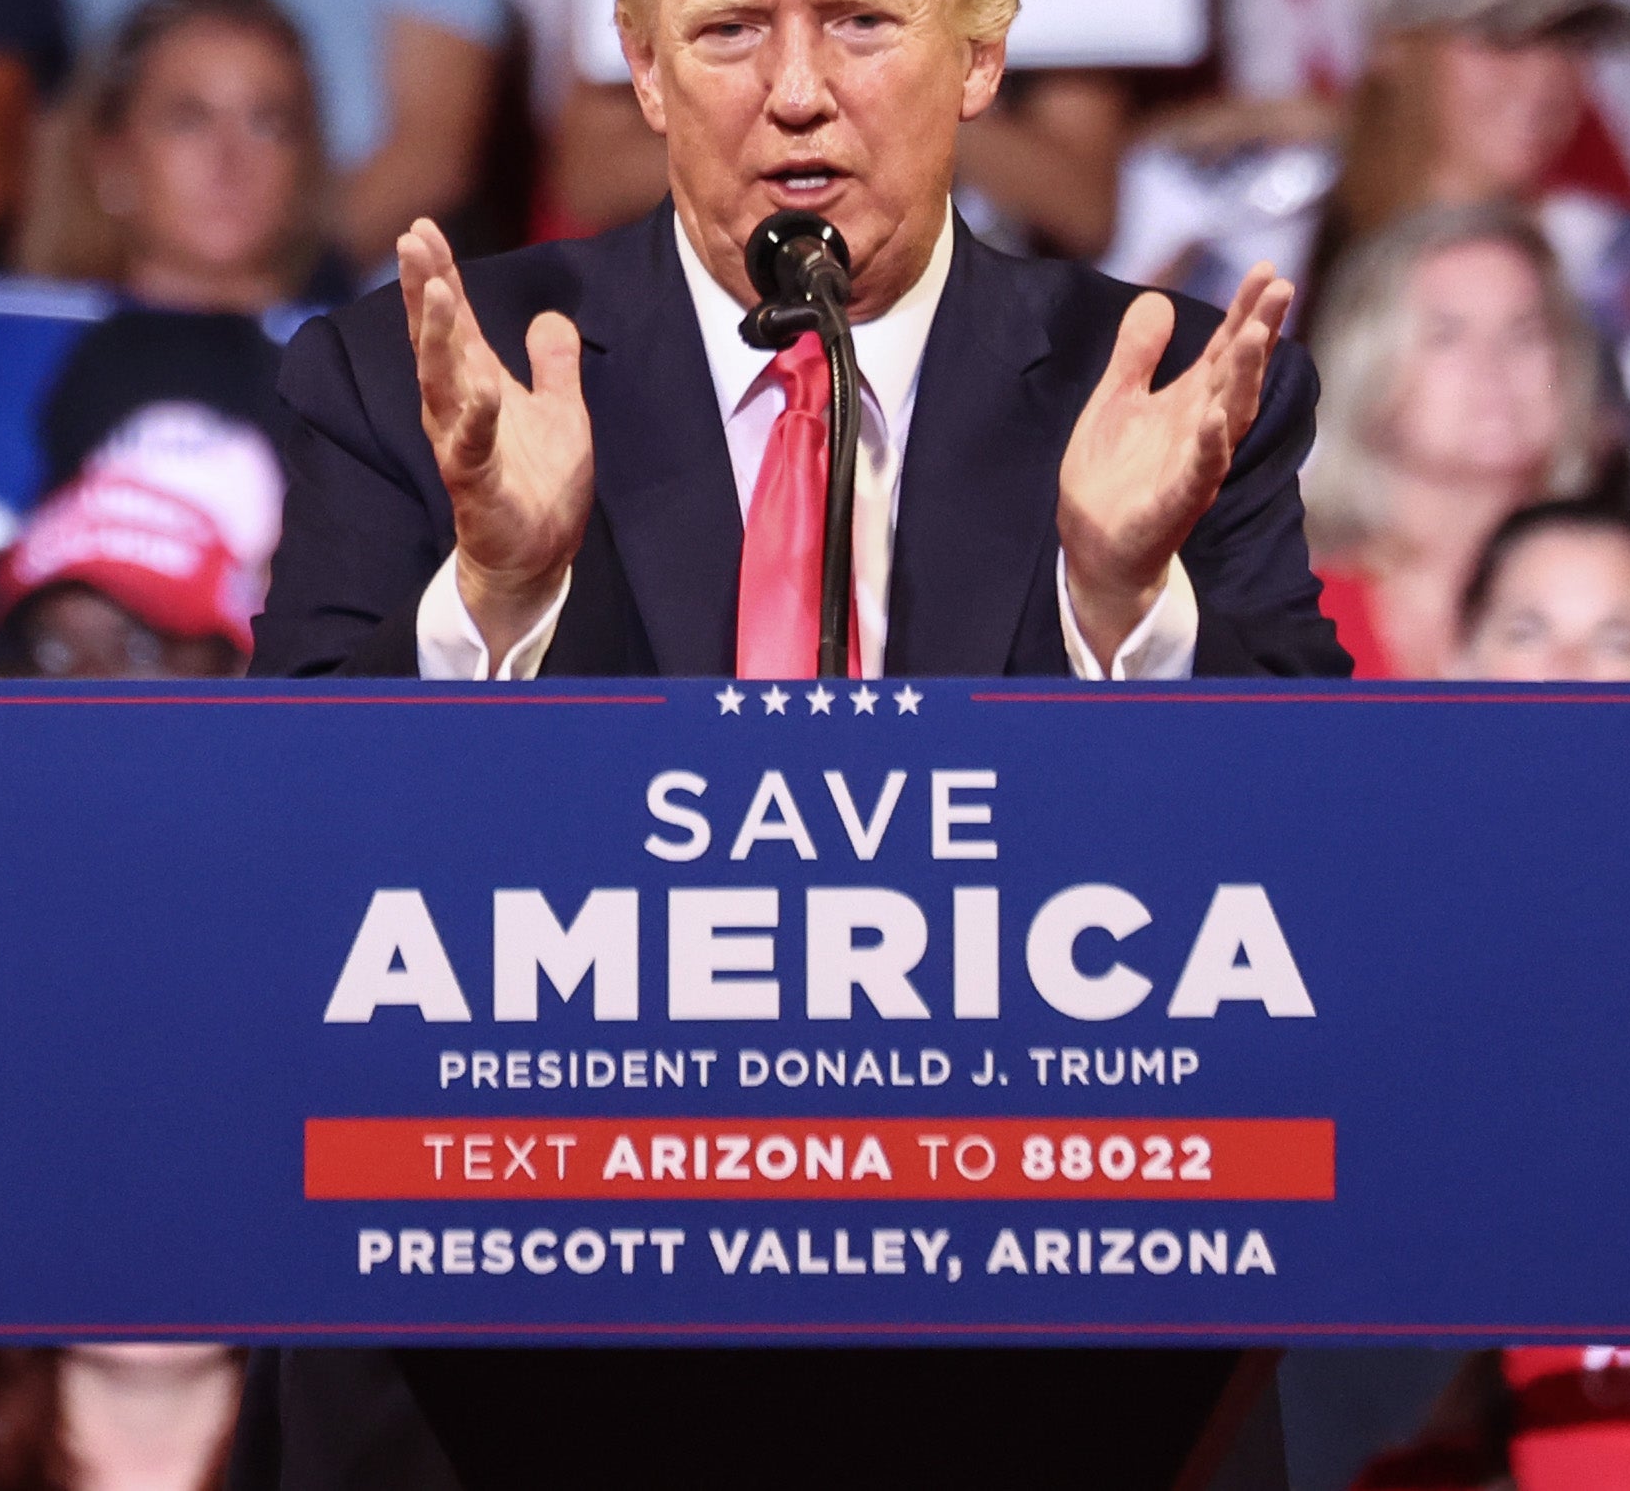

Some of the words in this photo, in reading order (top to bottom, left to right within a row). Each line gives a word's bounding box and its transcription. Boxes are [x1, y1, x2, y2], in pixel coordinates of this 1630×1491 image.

[643, 768, 999, 863] SAVE
[322, 882, 1318, 1024] AMERICA
[439, 1049, 718, 1089] PRESIDENT
[738, 1048, 952, 1088] DONALD
[970, 1048, 1009, 1087] J.
[1027, 1047, 1200, 1087] TRUMP
[422, 1134, 578, 1181] TEXT
[602, 1134, 893, 1181] ARIZONA
[917, 1135, 997, 1182] TO
[1020, 1134, 1213, 1182] 88022
[357, 1228, 686, 1275] PRESCOTT
[708, 1228, 963, 1283] VALLEY,
[985, 1228, 1277, 1276] ARIZONA
